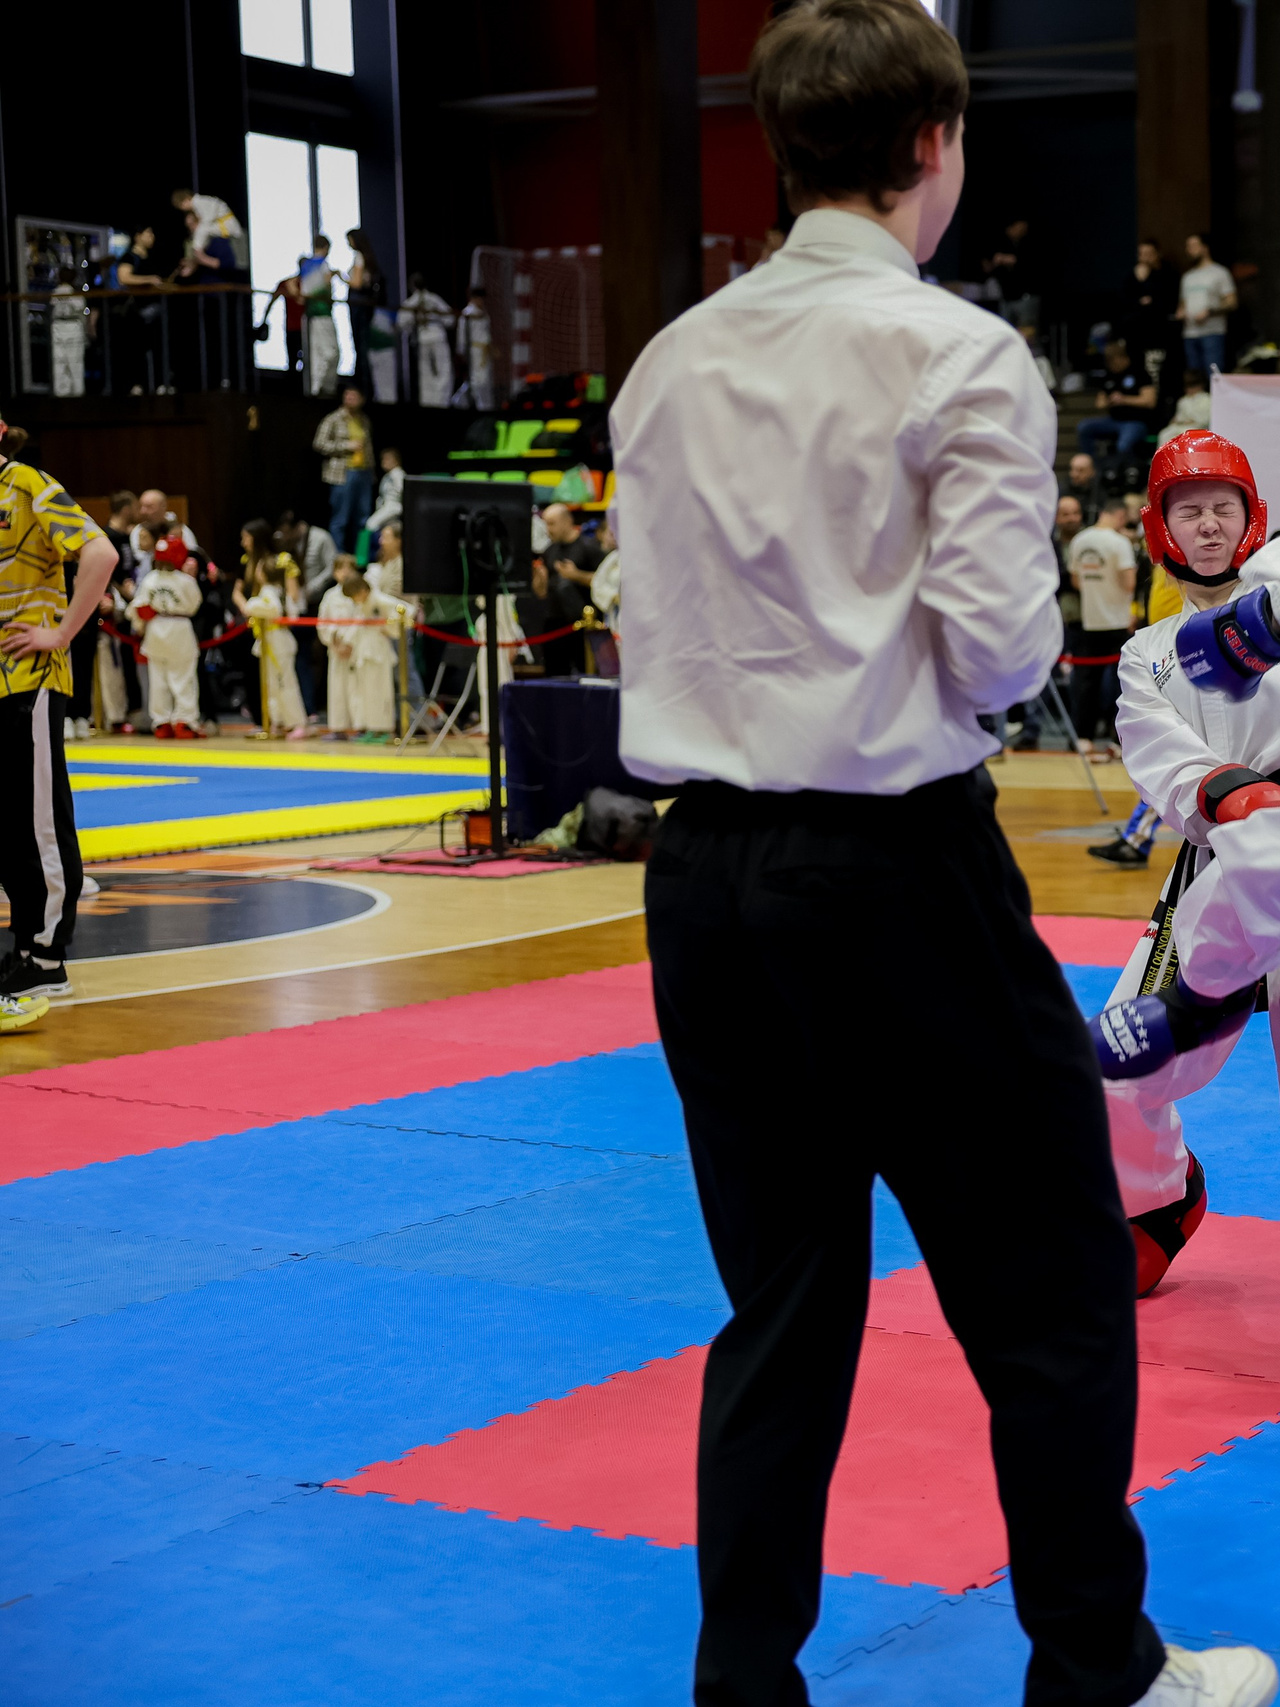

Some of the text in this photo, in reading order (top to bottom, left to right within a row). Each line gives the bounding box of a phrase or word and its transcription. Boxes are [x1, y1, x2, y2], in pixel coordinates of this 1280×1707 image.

[1223, 626, 1248, 657] TEN
[1152, 906, 1177, 966] TAEKWON-DO
[1141, 965, 1160, 997] FEDER
